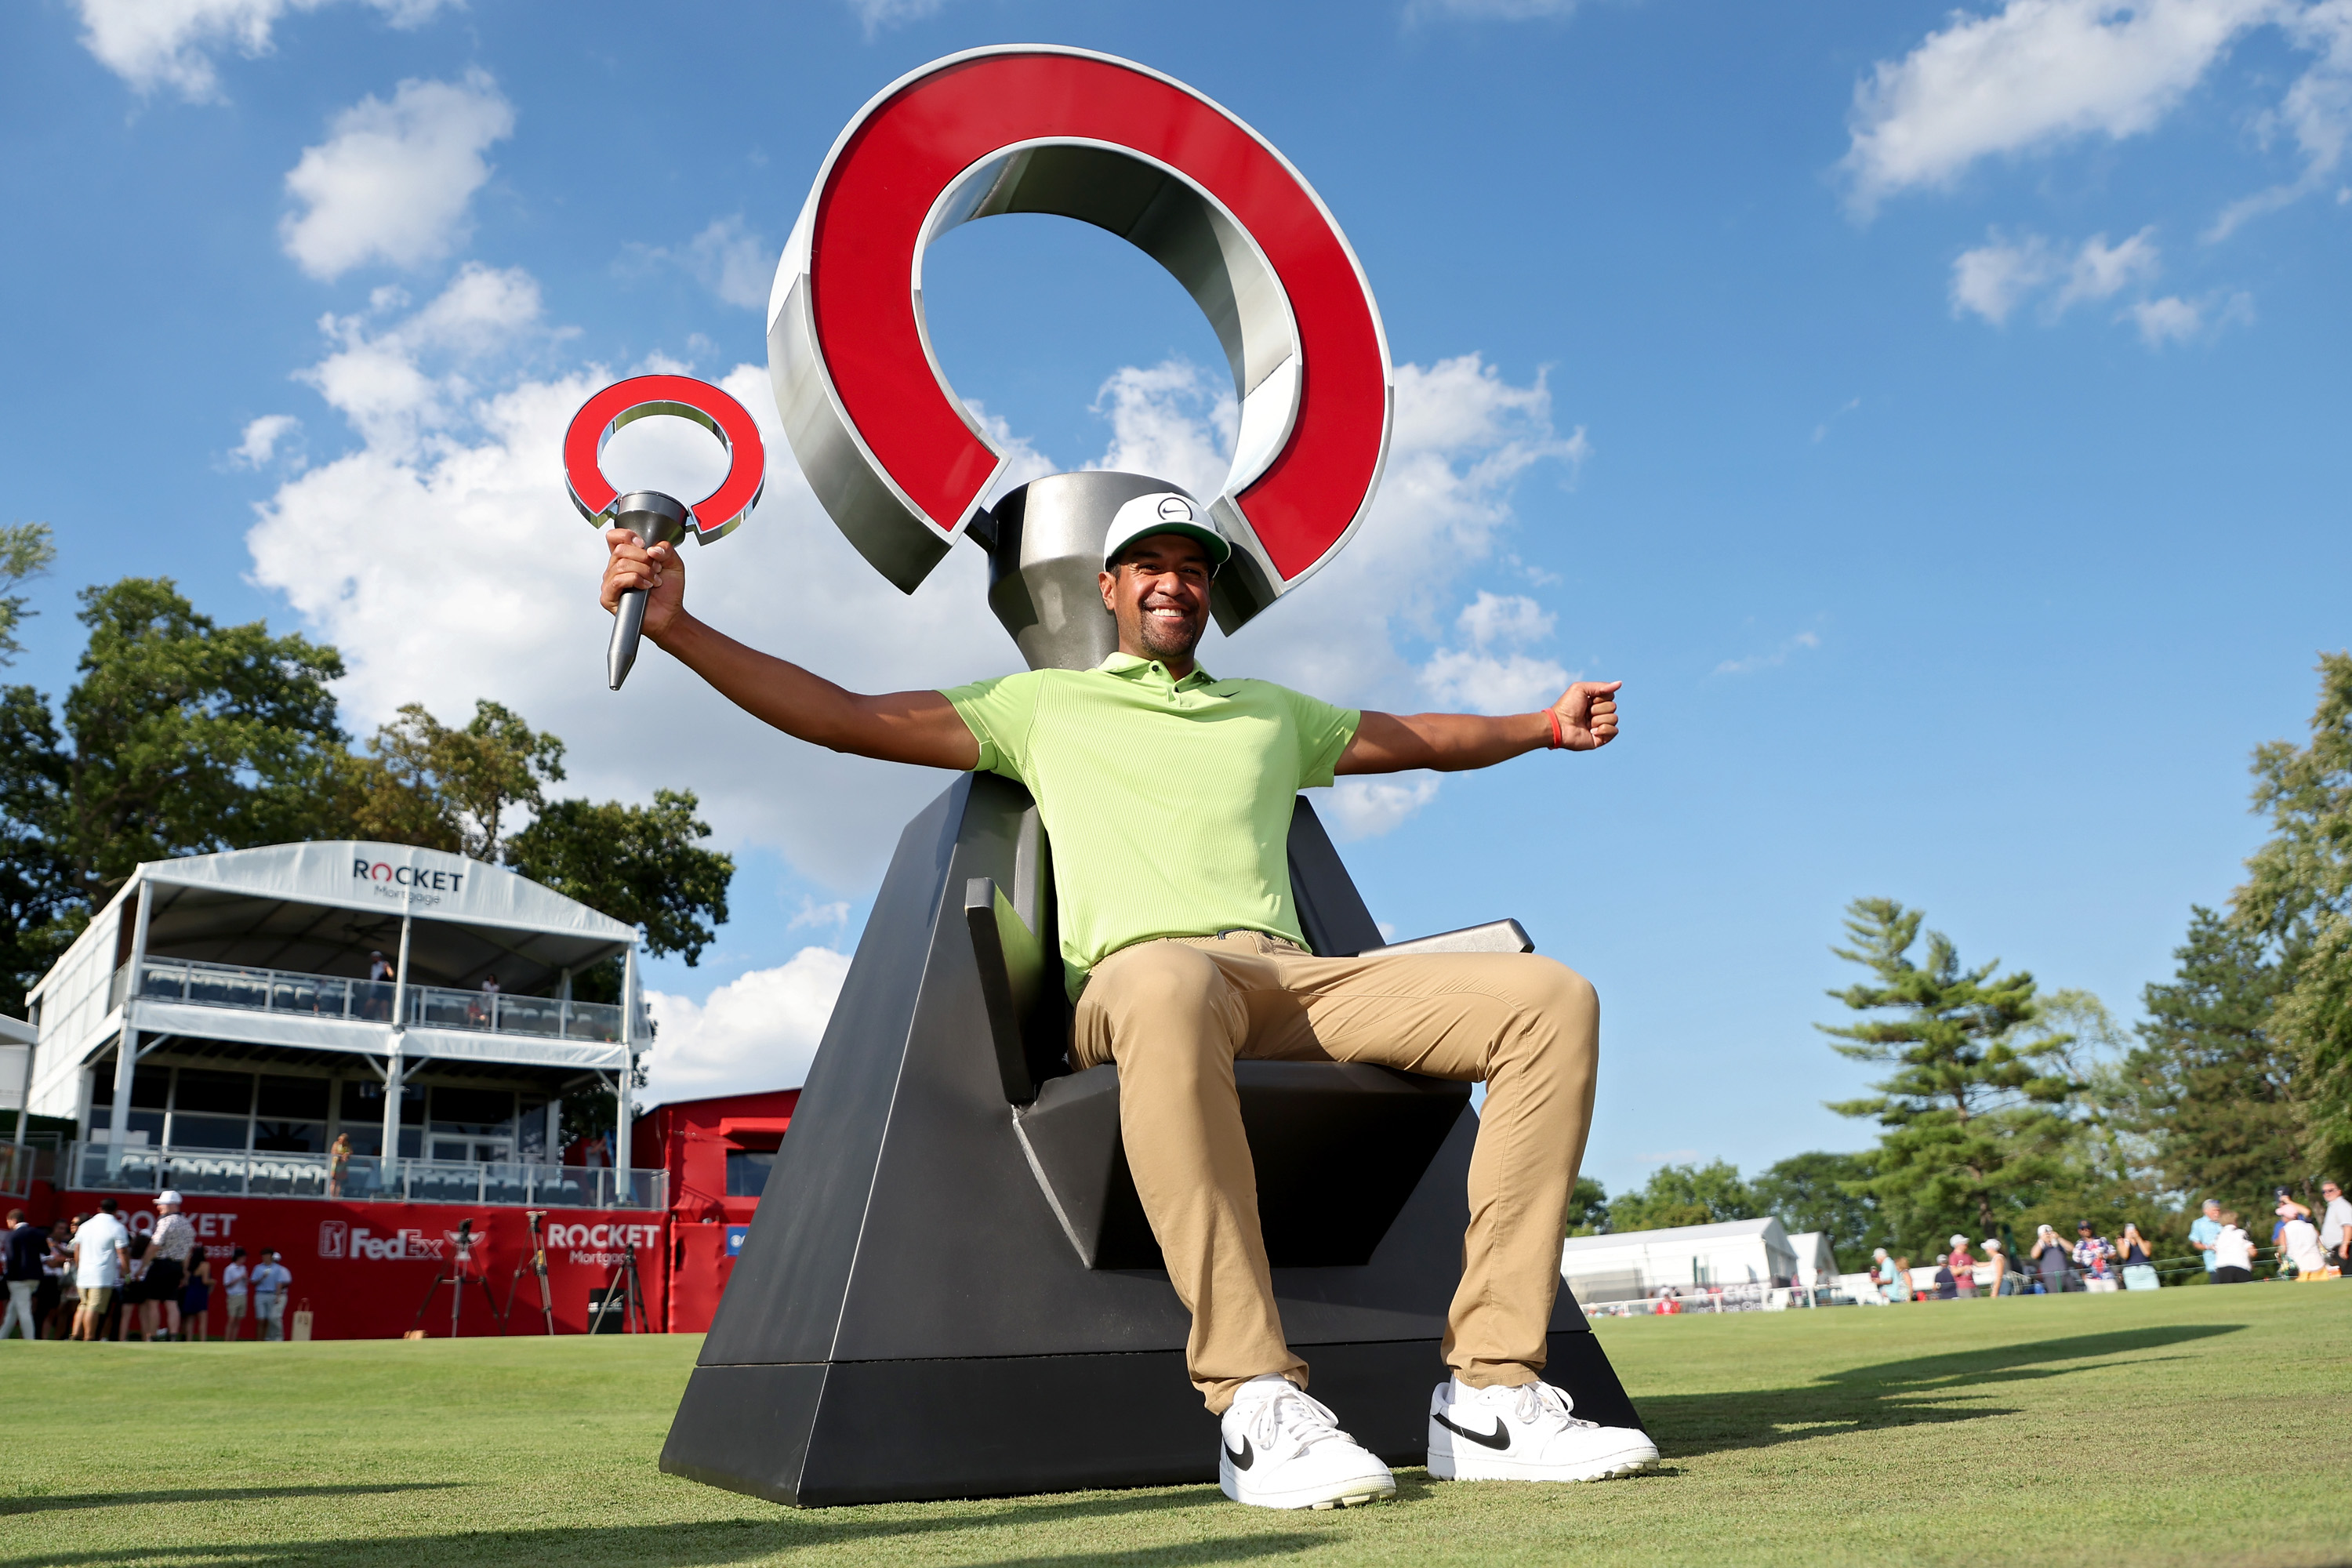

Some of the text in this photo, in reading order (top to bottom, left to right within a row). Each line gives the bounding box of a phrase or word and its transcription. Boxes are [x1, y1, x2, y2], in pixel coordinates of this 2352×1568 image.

[354, 859, 463, 891] ROCKET
[374, 885, 441, 904] Mortgage
[116, 1210, 238, 1236] OKET
[547, 1223, 661, 1248] ROCKET
[350, 1228, 444, 1260] FedEx
[569, 1250, 636, 1268] Mortgag
